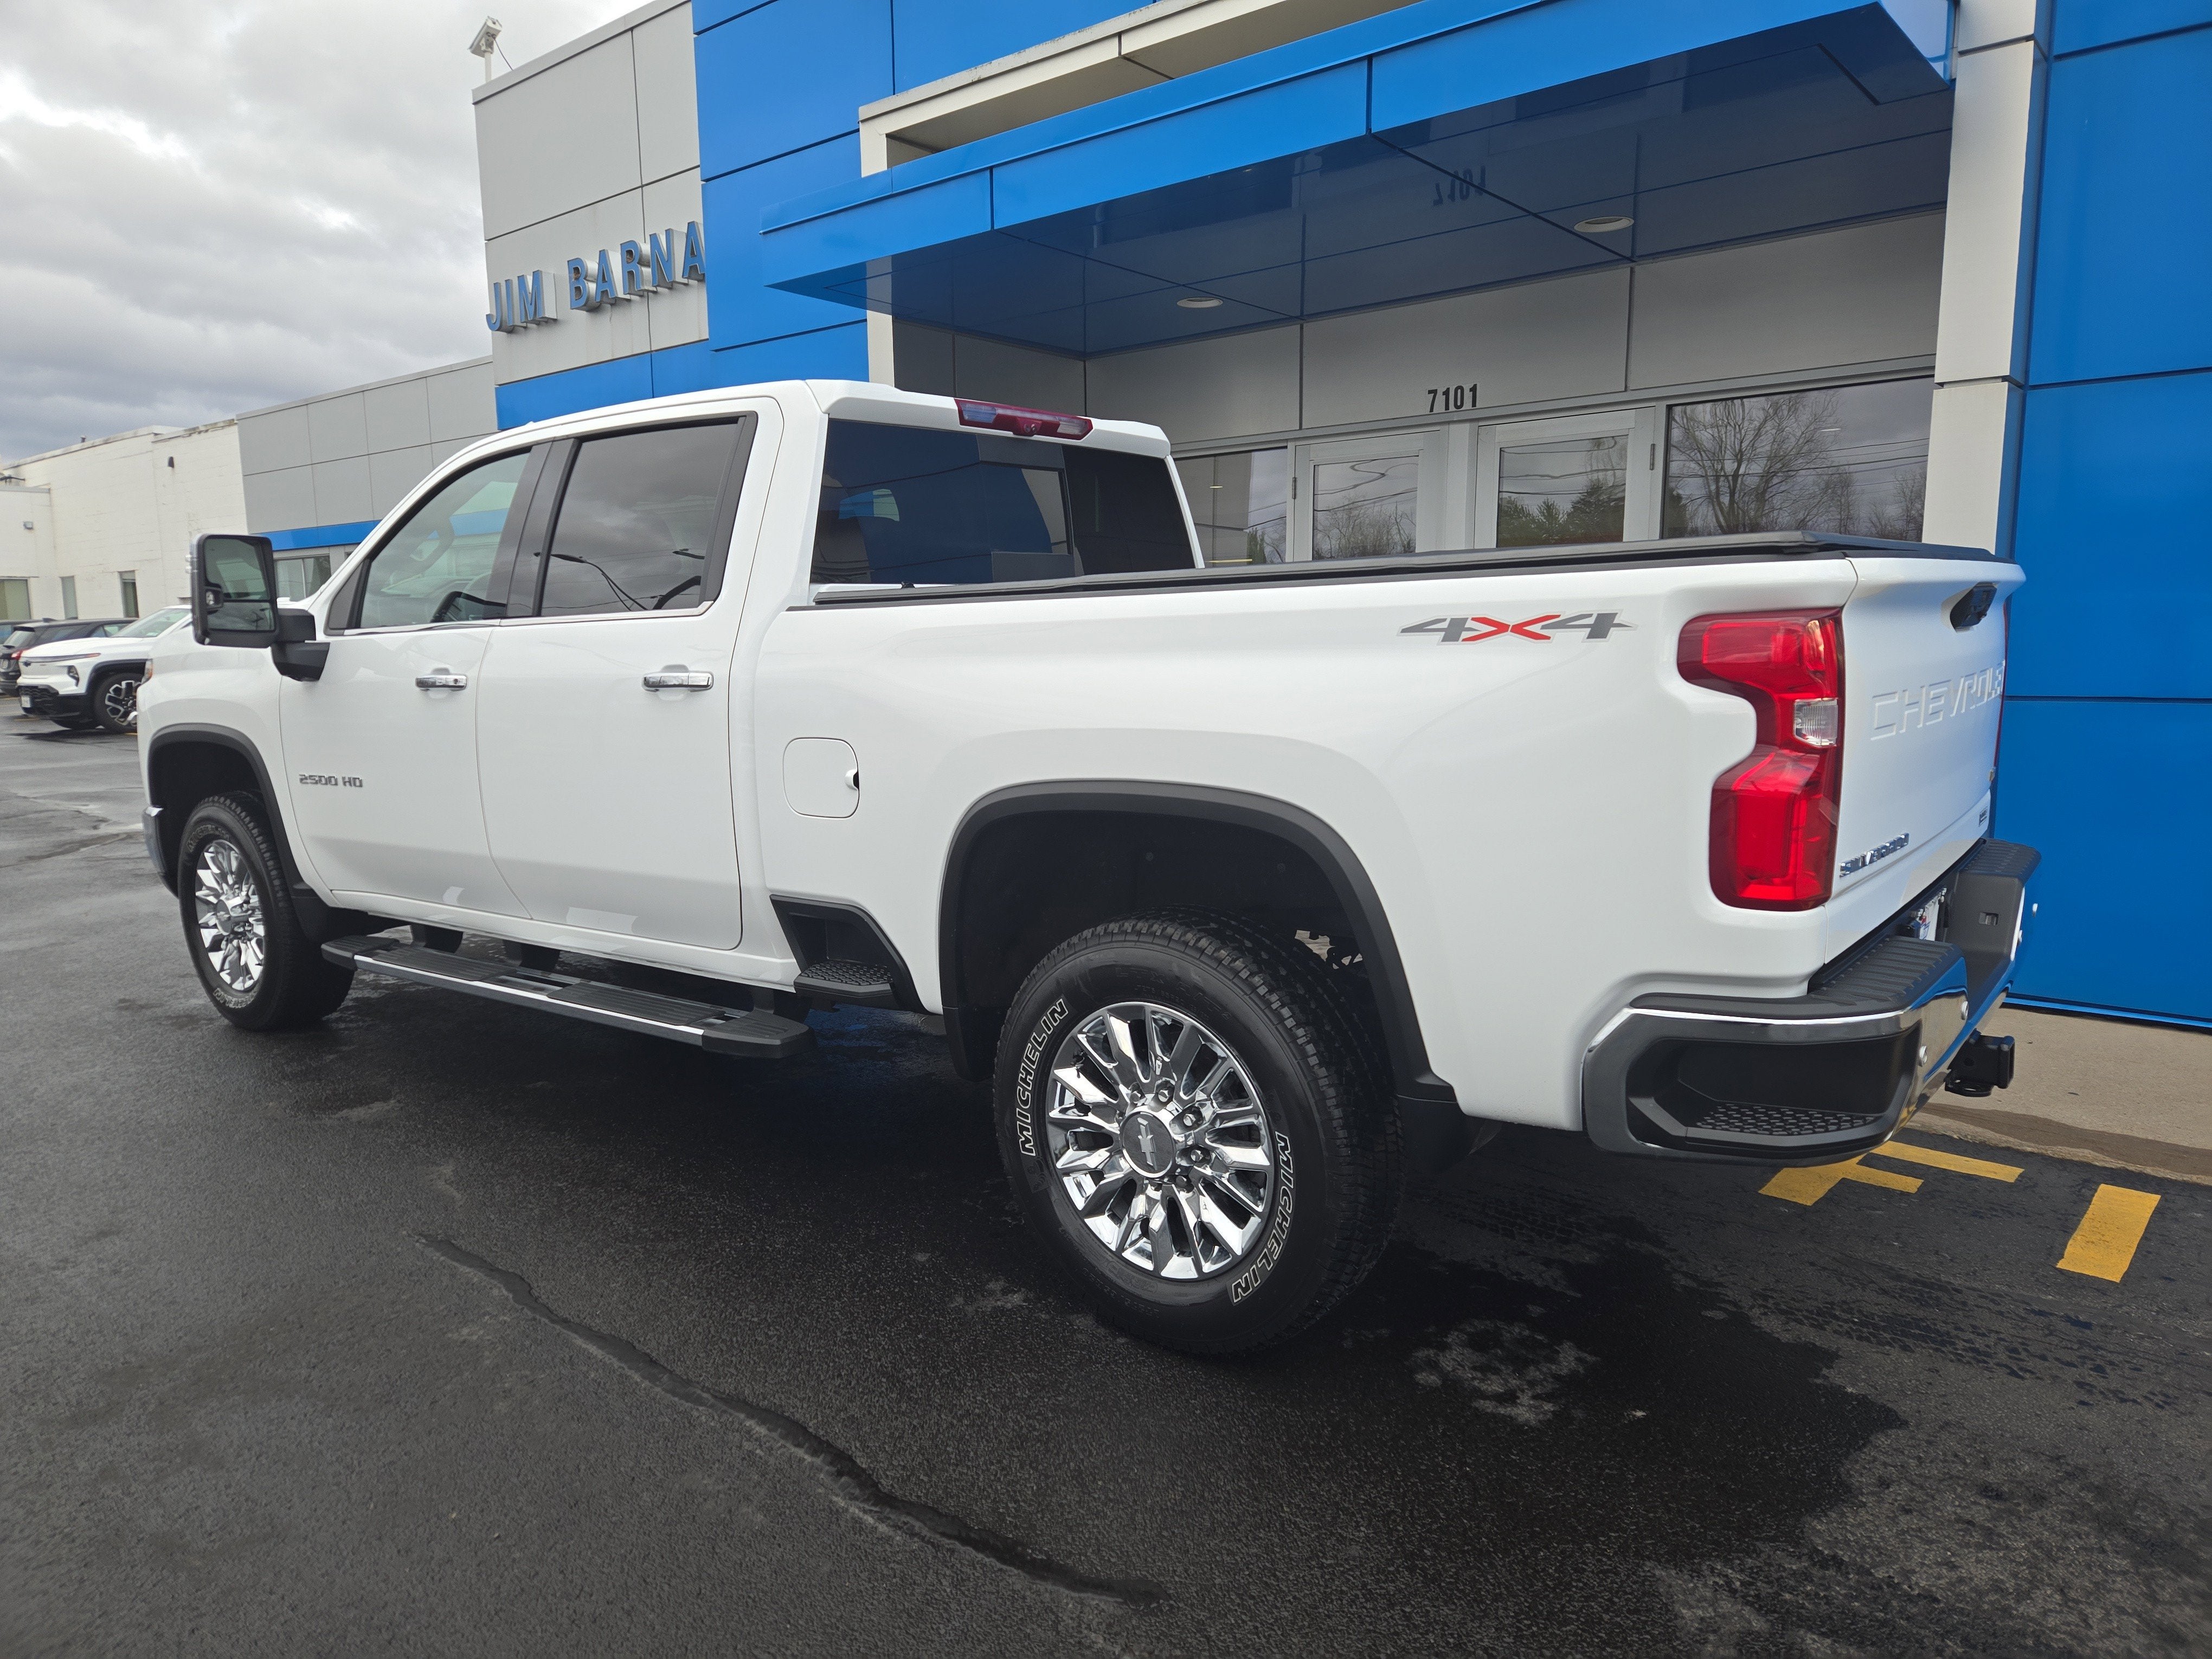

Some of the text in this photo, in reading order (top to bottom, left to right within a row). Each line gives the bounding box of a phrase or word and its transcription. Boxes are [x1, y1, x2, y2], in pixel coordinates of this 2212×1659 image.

[486, 270, 548, 332] JIM
[1427, 383, 1477, 413] 7101
[299, 774, 363, 787] 2500 HD
[1017, 998, 1069, 1156] MICHELIN
[1231, 1131, 1295, 1303] MICHELIN
